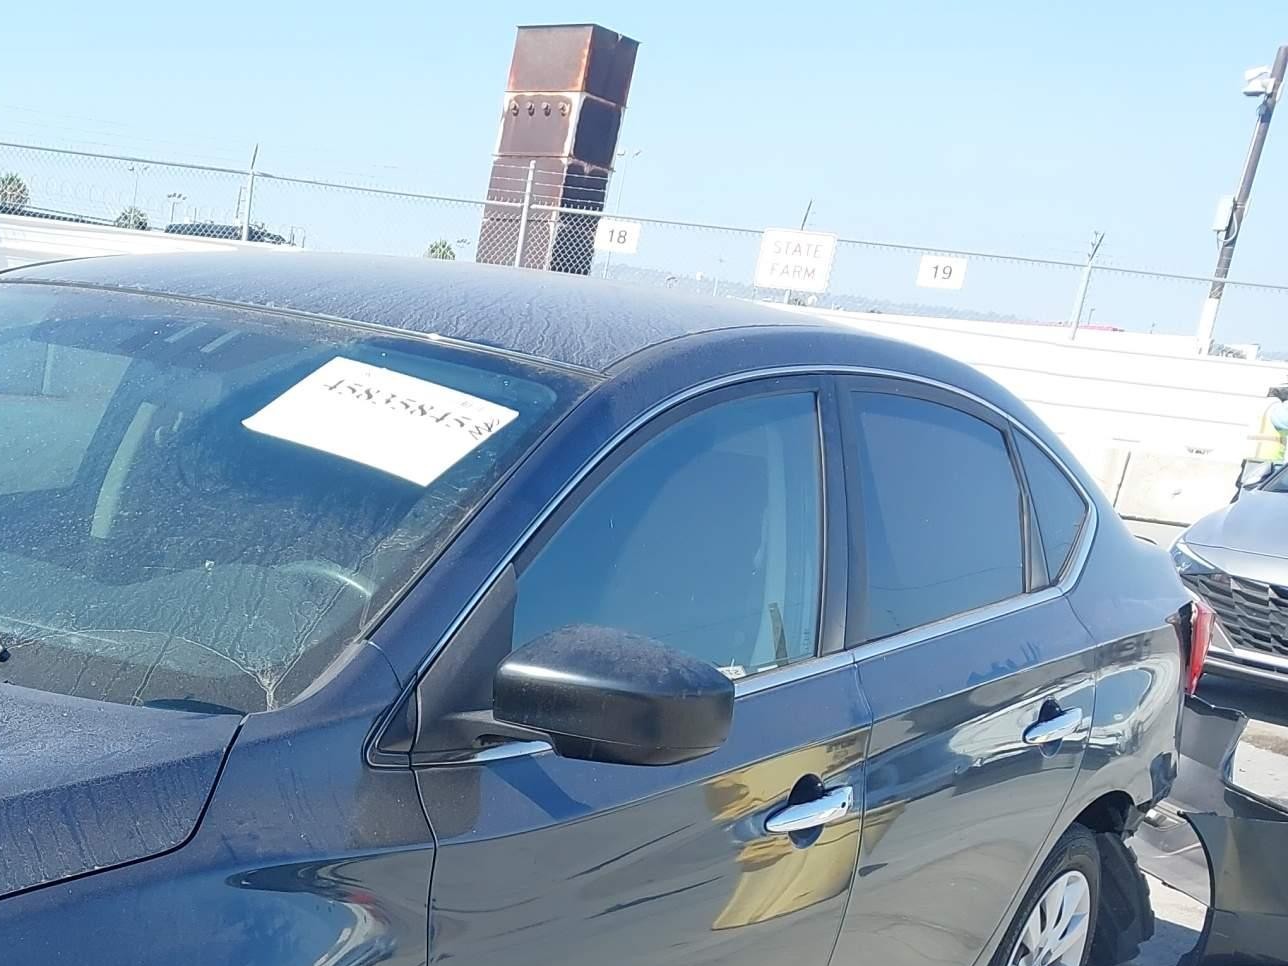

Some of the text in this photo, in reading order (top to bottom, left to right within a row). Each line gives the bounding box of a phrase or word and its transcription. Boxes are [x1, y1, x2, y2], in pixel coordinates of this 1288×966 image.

[609, 229, 627, 244] 18
[773, 240, 824, 258] STATE
[770, 262, 816, 281] FARM
[932, 264, 953, 280] 19
